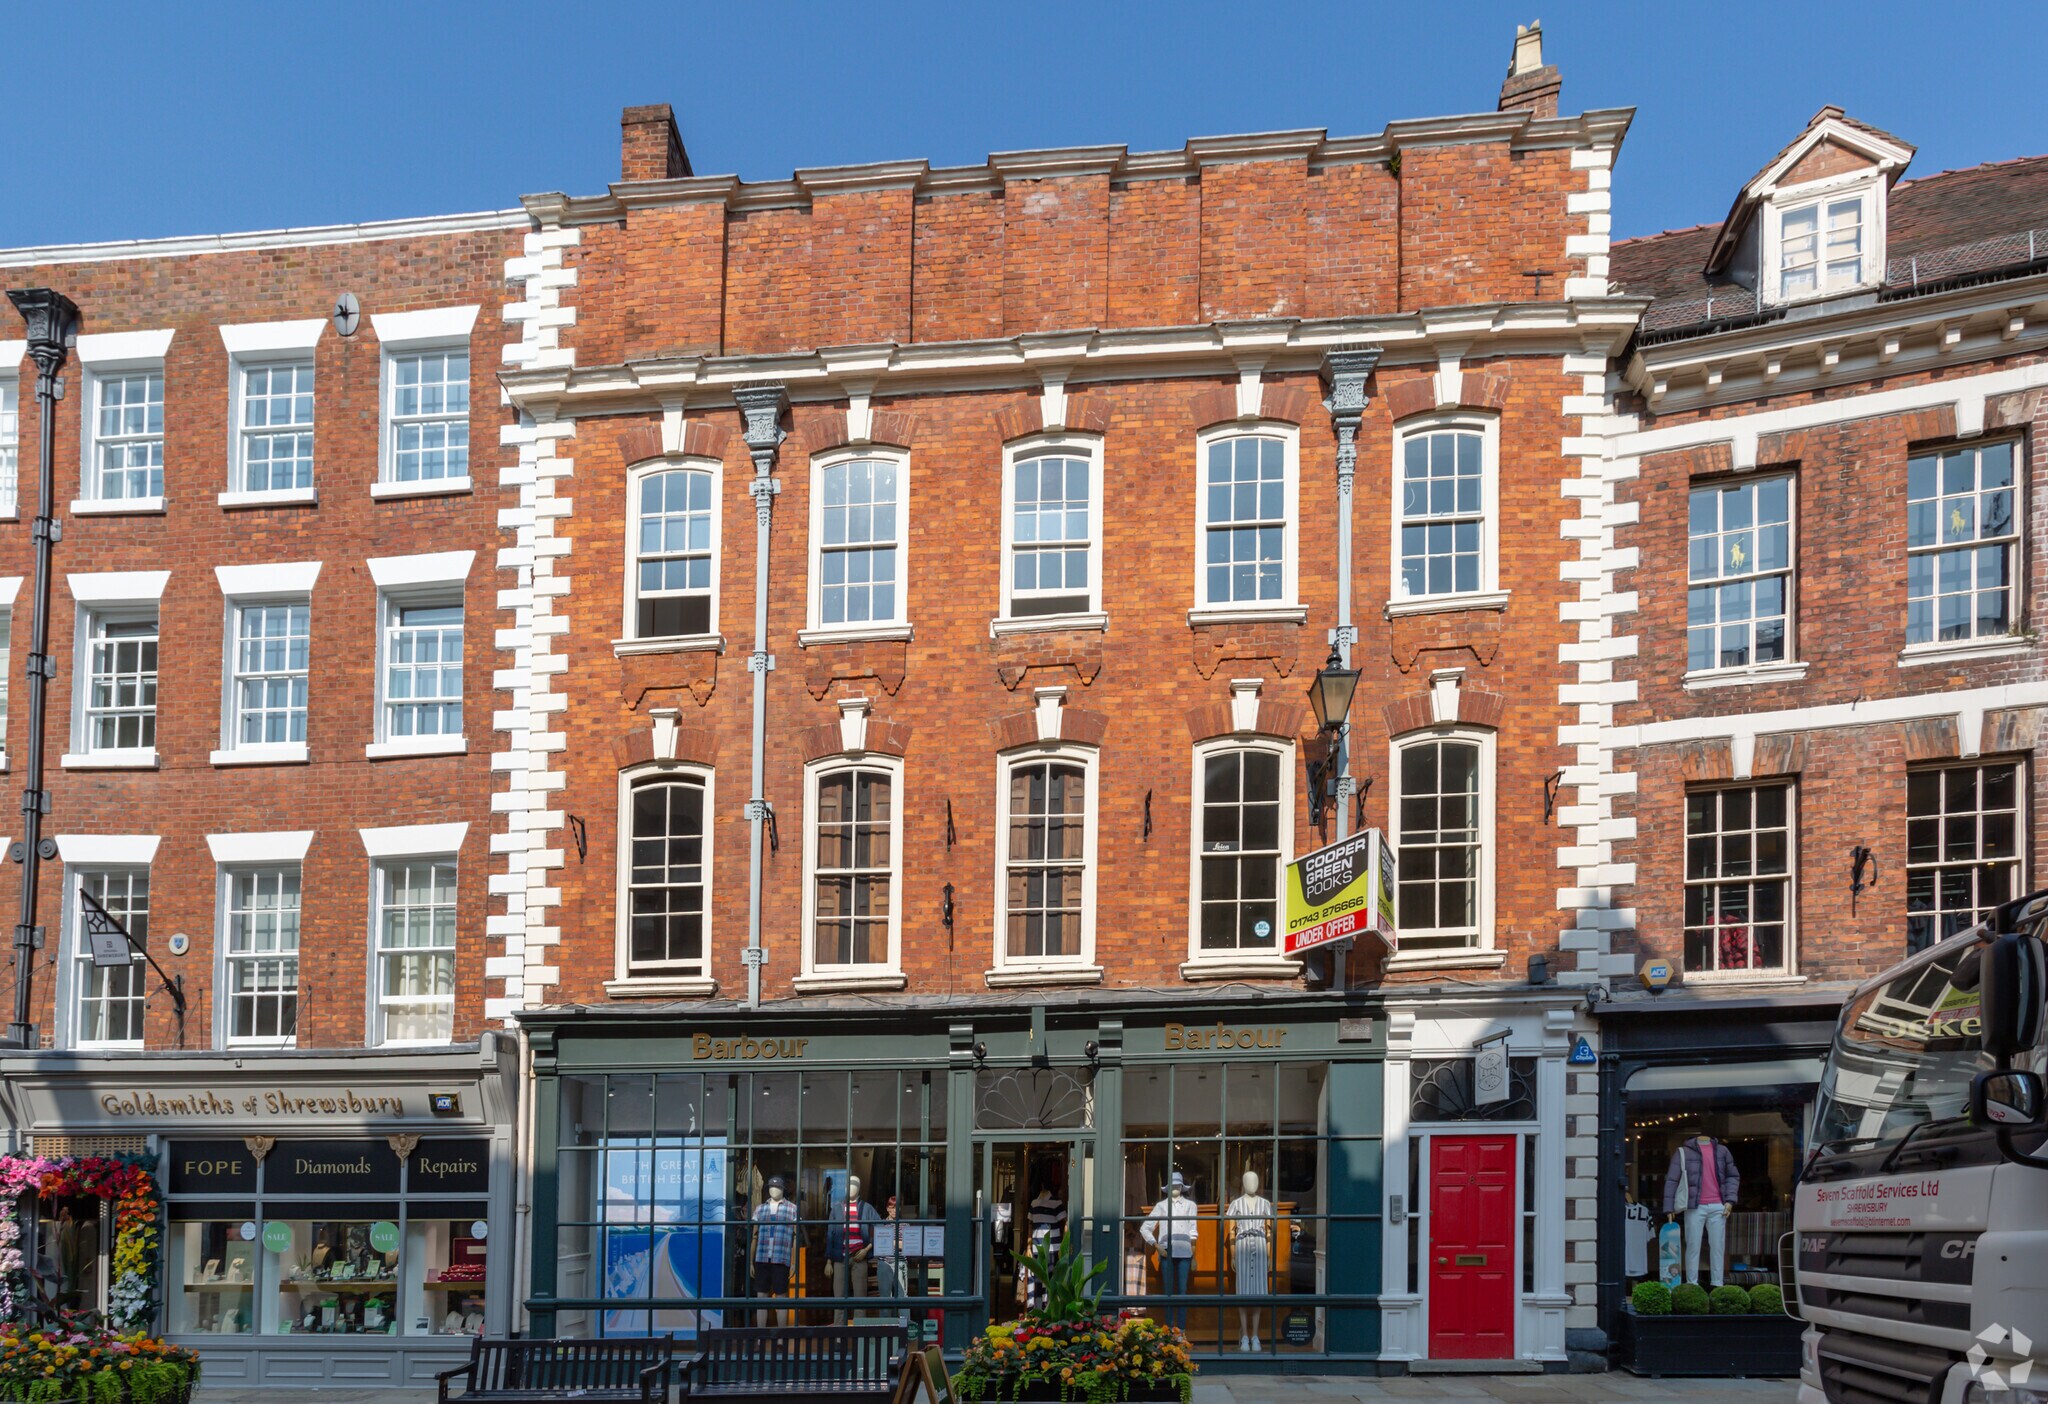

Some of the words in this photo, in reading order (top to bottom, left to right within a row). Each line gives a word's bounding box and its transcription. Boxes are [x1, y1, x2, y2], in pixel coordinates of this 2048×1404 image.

[1305, 838, 1366, 872] COOPER
[1306, 856, 1353, 885] GREEN
[1307, 870, 1353, 899] POOKS
[1290, 911, 1320, 929] 01743
[1322, 896, 1364, 918] 276666
[1295, 925, 1324, 948] UNDER
[1326, 914, 1355, 938] OFFER
[1651, 967, 1667, 977] ADT
[1165, 1021, 1288, 1050] Barbour
[692, 1032, 809, 1060] Barbour
[101, 1090, 235, 1116] Goldsmiths
[242, 1095, 258, 1116] of
[264, 1089, 404, 1118] Shrewsbury
[437, 1098, 451, 1108] ADT
[184, 1160, 243, 1175] FOPE
[295, 1156, 371, 1174] Diamonds
[420, 1158, 477, 1178] Repairs
[661, 1160, 698, 1170] GREAT
[670, 1173, 713, 1183] ESCAE
[1816, 1188, 1840, 1202] Severn
[1841, 1184, 1875, 1201] Scaffold
[1876, 1182, 1918, 1199] Services
[1920, 1180, 1940, 1197] Ltd
[1846, 1202, 1888, 1213] SHREWSBURY
[267, 1232, 288, 1241] SALE
[374, 1232, 395, 1241] SALE
[1801, 1238, 1827, 1252] DAF
